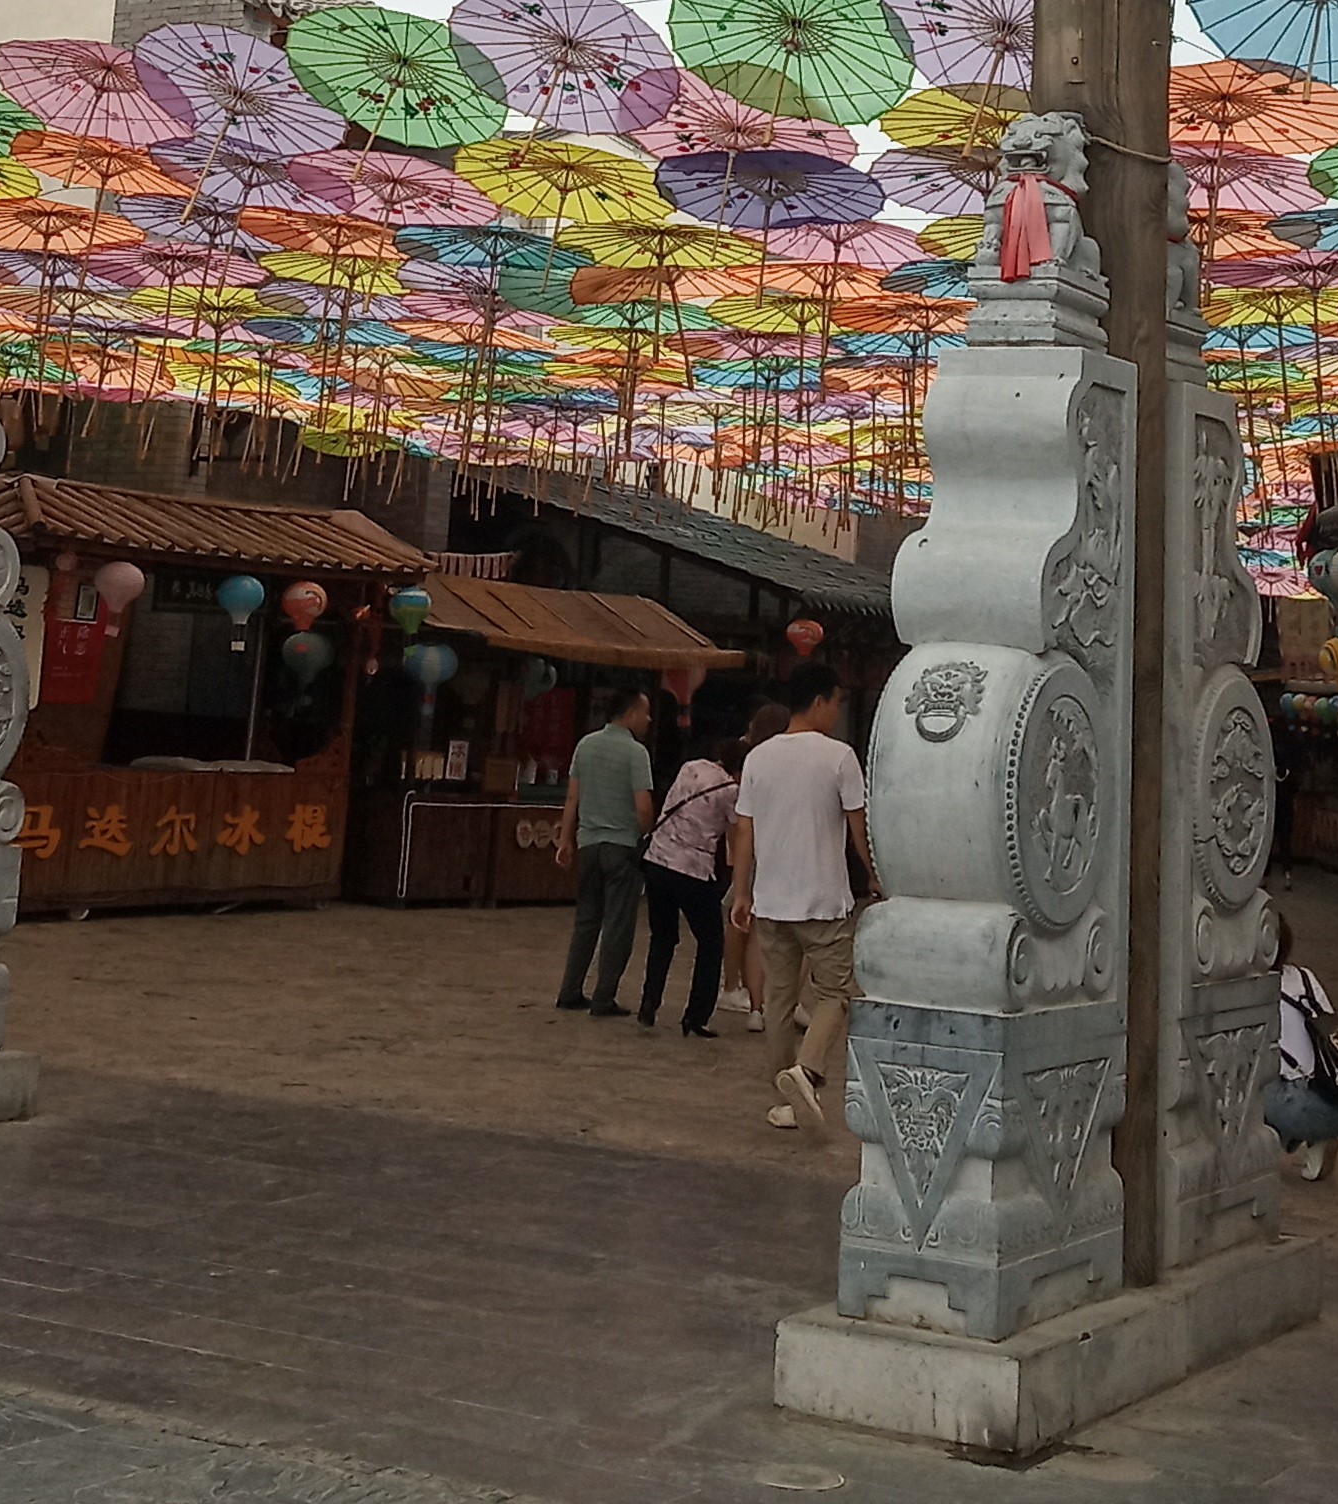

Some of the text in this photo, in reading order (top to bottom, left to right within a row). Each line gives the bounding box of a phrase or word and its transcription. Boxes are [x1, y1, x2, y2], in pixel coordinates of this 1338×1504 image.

[15, 804, 332, 859] 马迭尔冰棍
